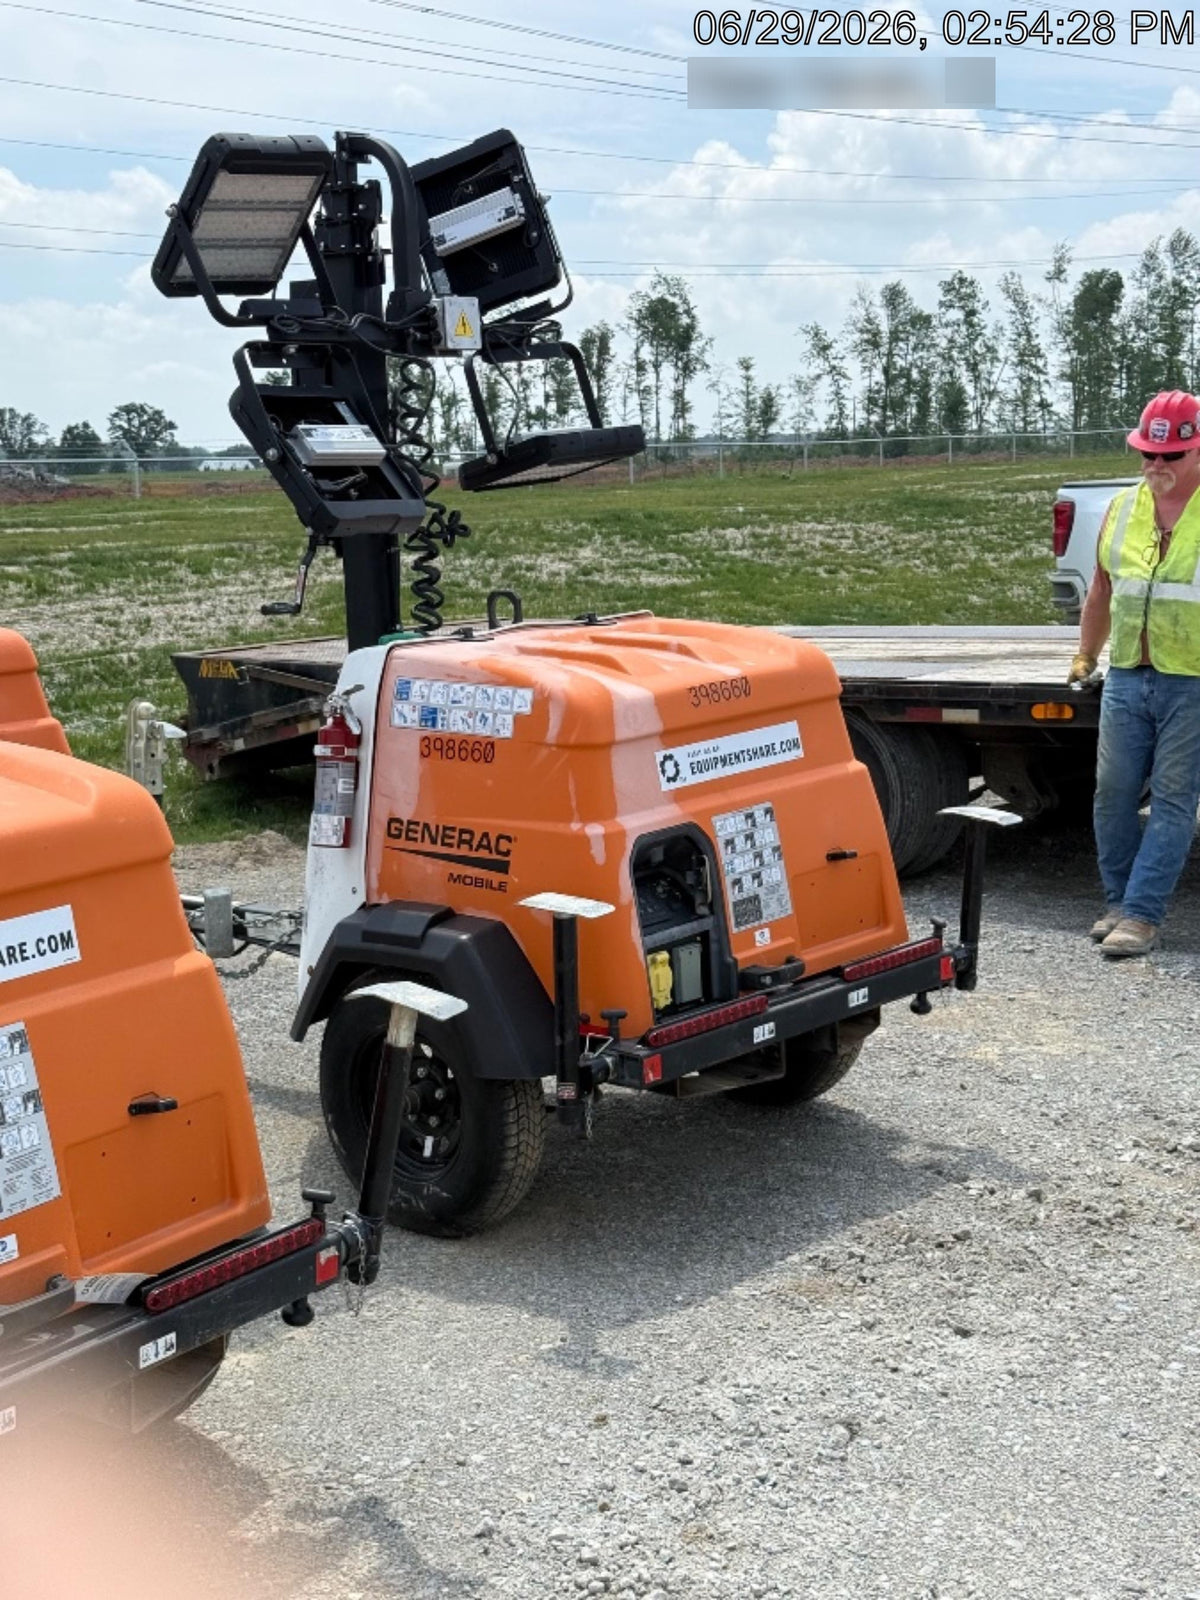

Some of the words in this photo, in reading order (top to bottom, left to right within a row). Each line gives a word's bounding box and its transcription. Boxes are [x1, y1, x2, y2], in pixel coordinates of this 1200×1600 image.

[688, 676, 751, 708] 398660
[420, 735, 495, 763] 398660
[689, 737, 801, 776] EQUIPMENTSHARE.COM
[386, 817, 513, 858] GENERAC
[447, 872, 508, 893] MOBILE
